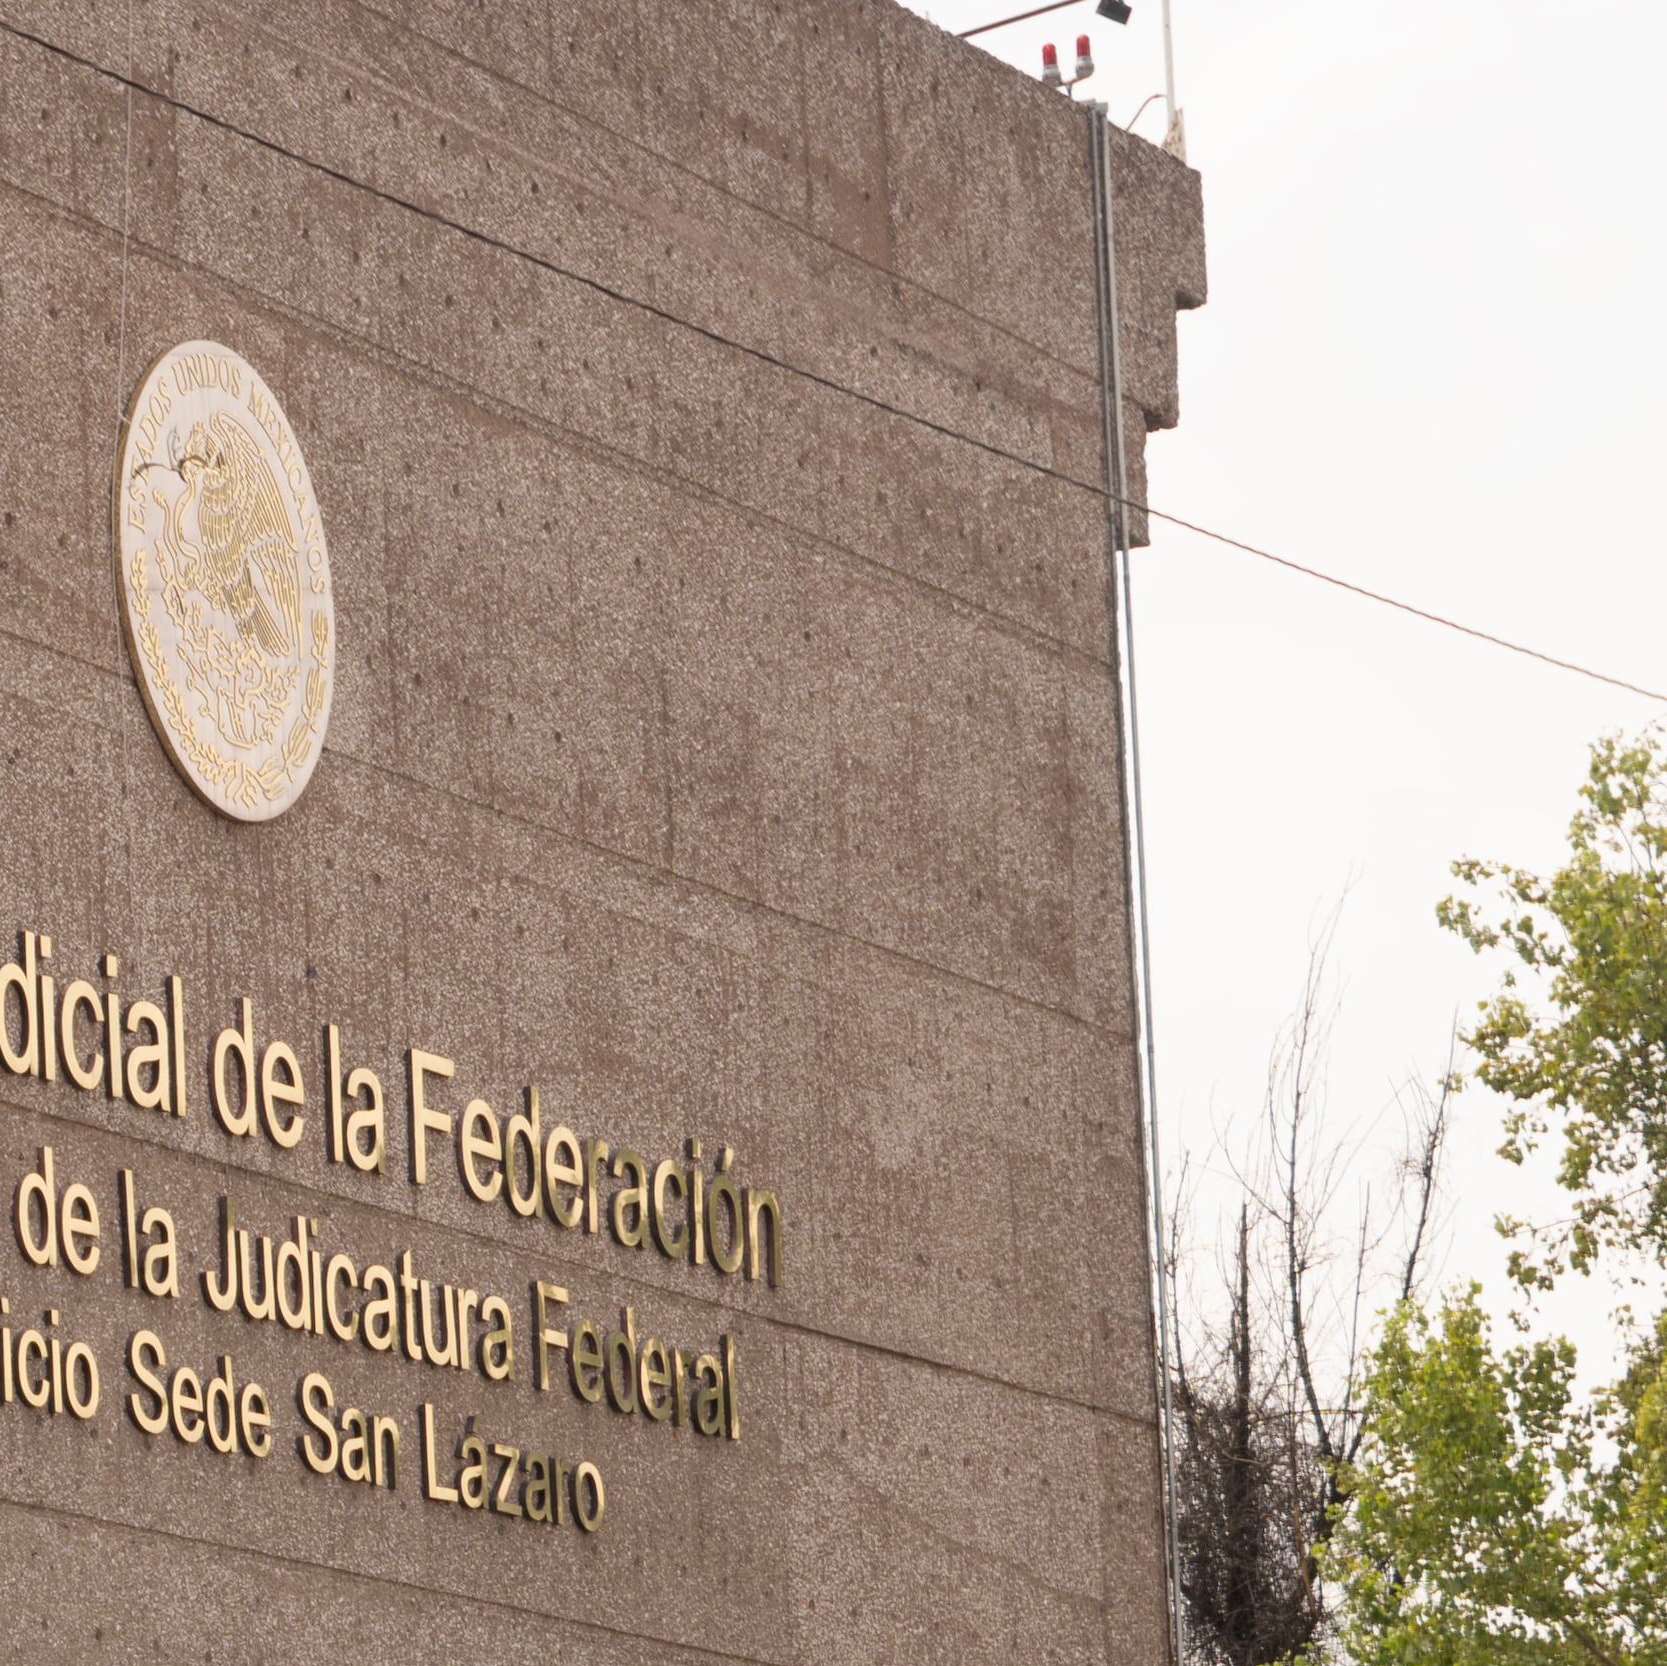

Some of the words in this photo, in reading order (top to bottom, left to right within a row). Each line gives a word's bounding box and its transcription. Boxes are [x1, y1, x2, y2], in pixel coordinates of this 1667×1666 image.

[171, 352, 242, 398] UNIDOS
[247, 380, 328, 596] MEXICANOS
[212, 997, 305, 1149] de
[327, 1024, 386, 1175] la
[409, 1048, 783, 1288] Federación
[16, 1145, 101, 1275] de
[124, 1168, 181, 1298] la
[205, 1196, 515, 1383] Judicatura
[533, 1280, 741, 1440] Federal
[129, 1330, 271, 1459] Sede
[300, 1372, 401, 1490] San
[422, 1402, 606, 1532] Lázaro
